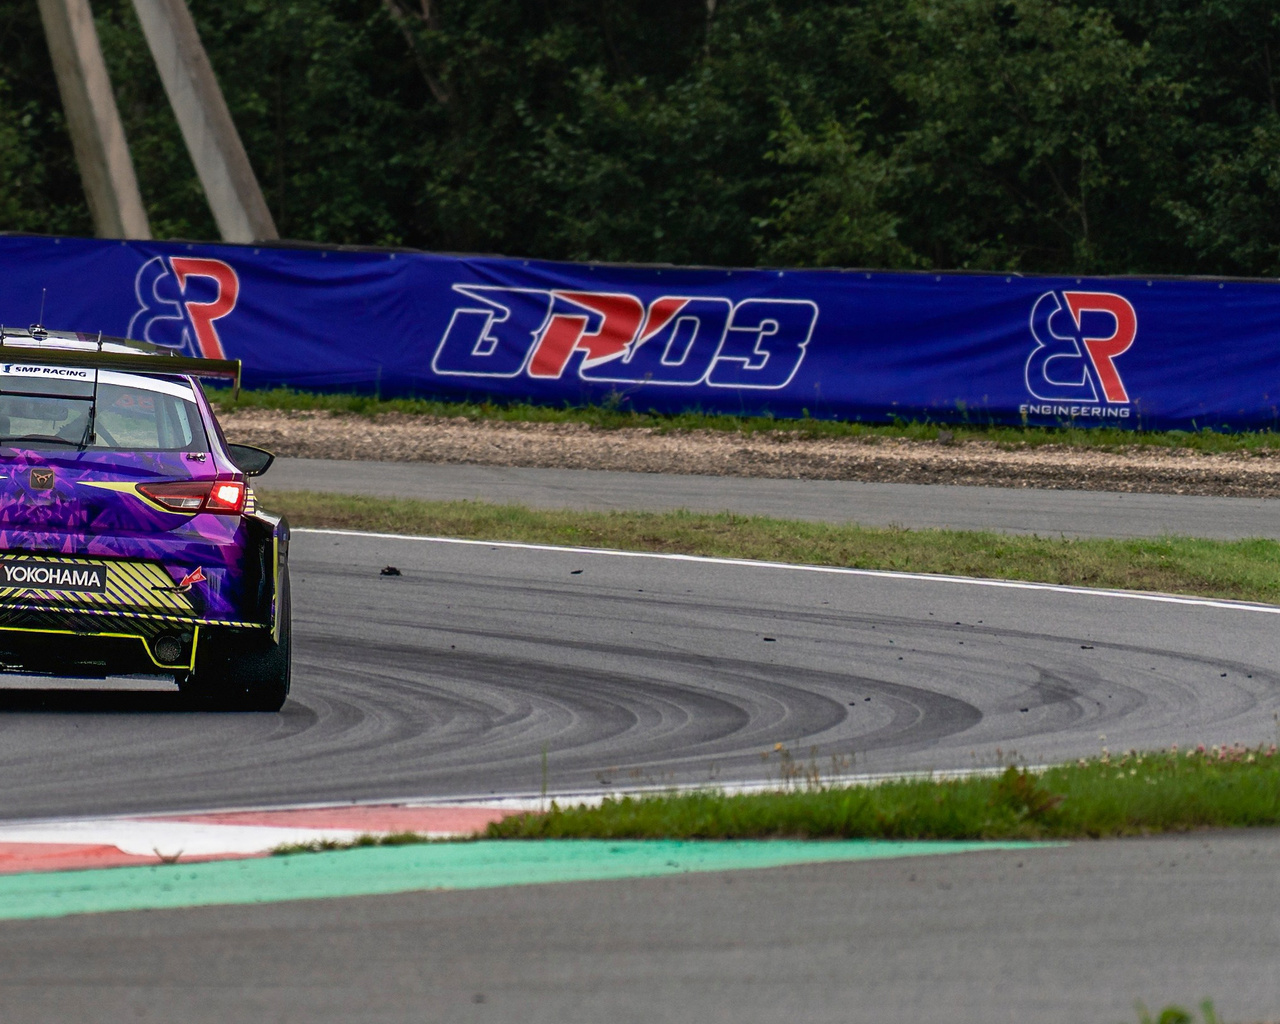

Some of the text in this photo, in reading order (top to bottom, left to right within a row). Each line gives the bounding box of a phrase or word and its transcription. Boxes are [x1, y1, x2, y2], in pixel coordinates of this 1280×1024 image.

[43, 368, 87, 377] RACING
[1019, 404, 1131, 418] ENGINEERING
[3, 565, 101, 588] YOKOHAMA
